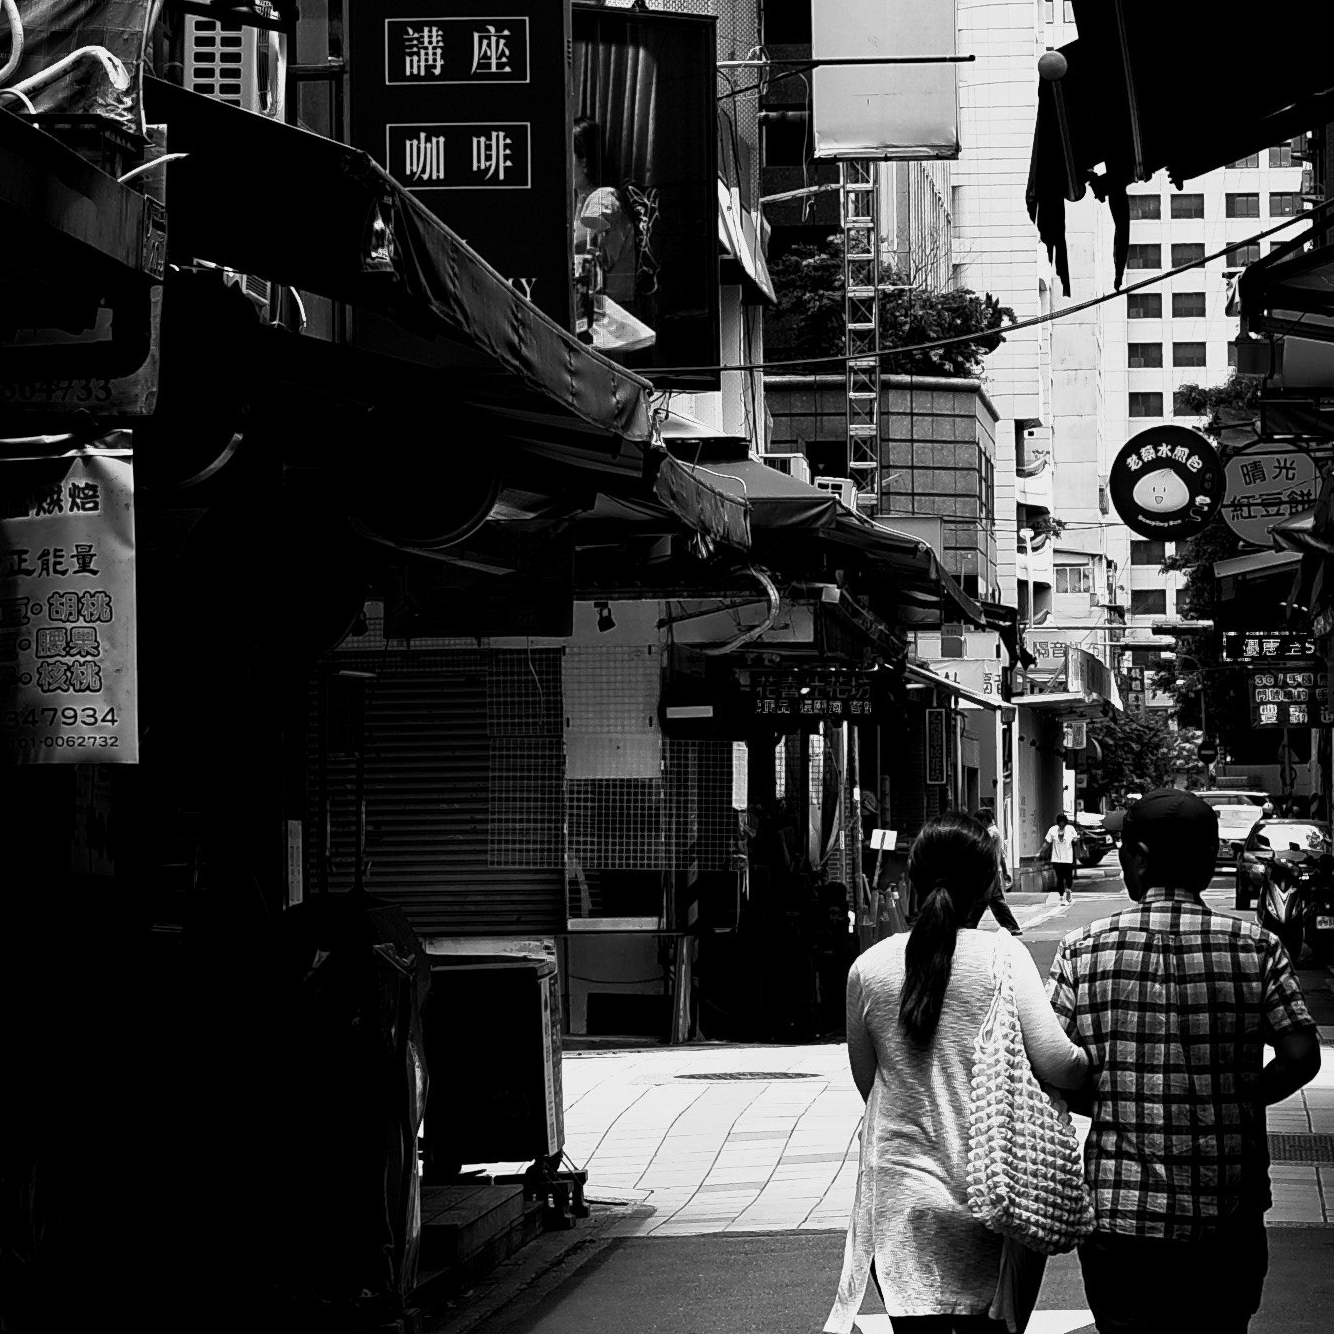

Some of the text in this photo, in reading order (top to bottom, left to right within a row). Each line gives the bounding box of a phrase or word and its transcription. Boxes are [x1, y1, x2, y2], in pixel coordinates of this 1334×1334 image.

[403, 24, 514, 78] 講座
[404, 130, 514, 183] 咖啡
[1239, 456, 1297, 486] 晴光
[1229, 488, 1314, 522] 紅豆餅
